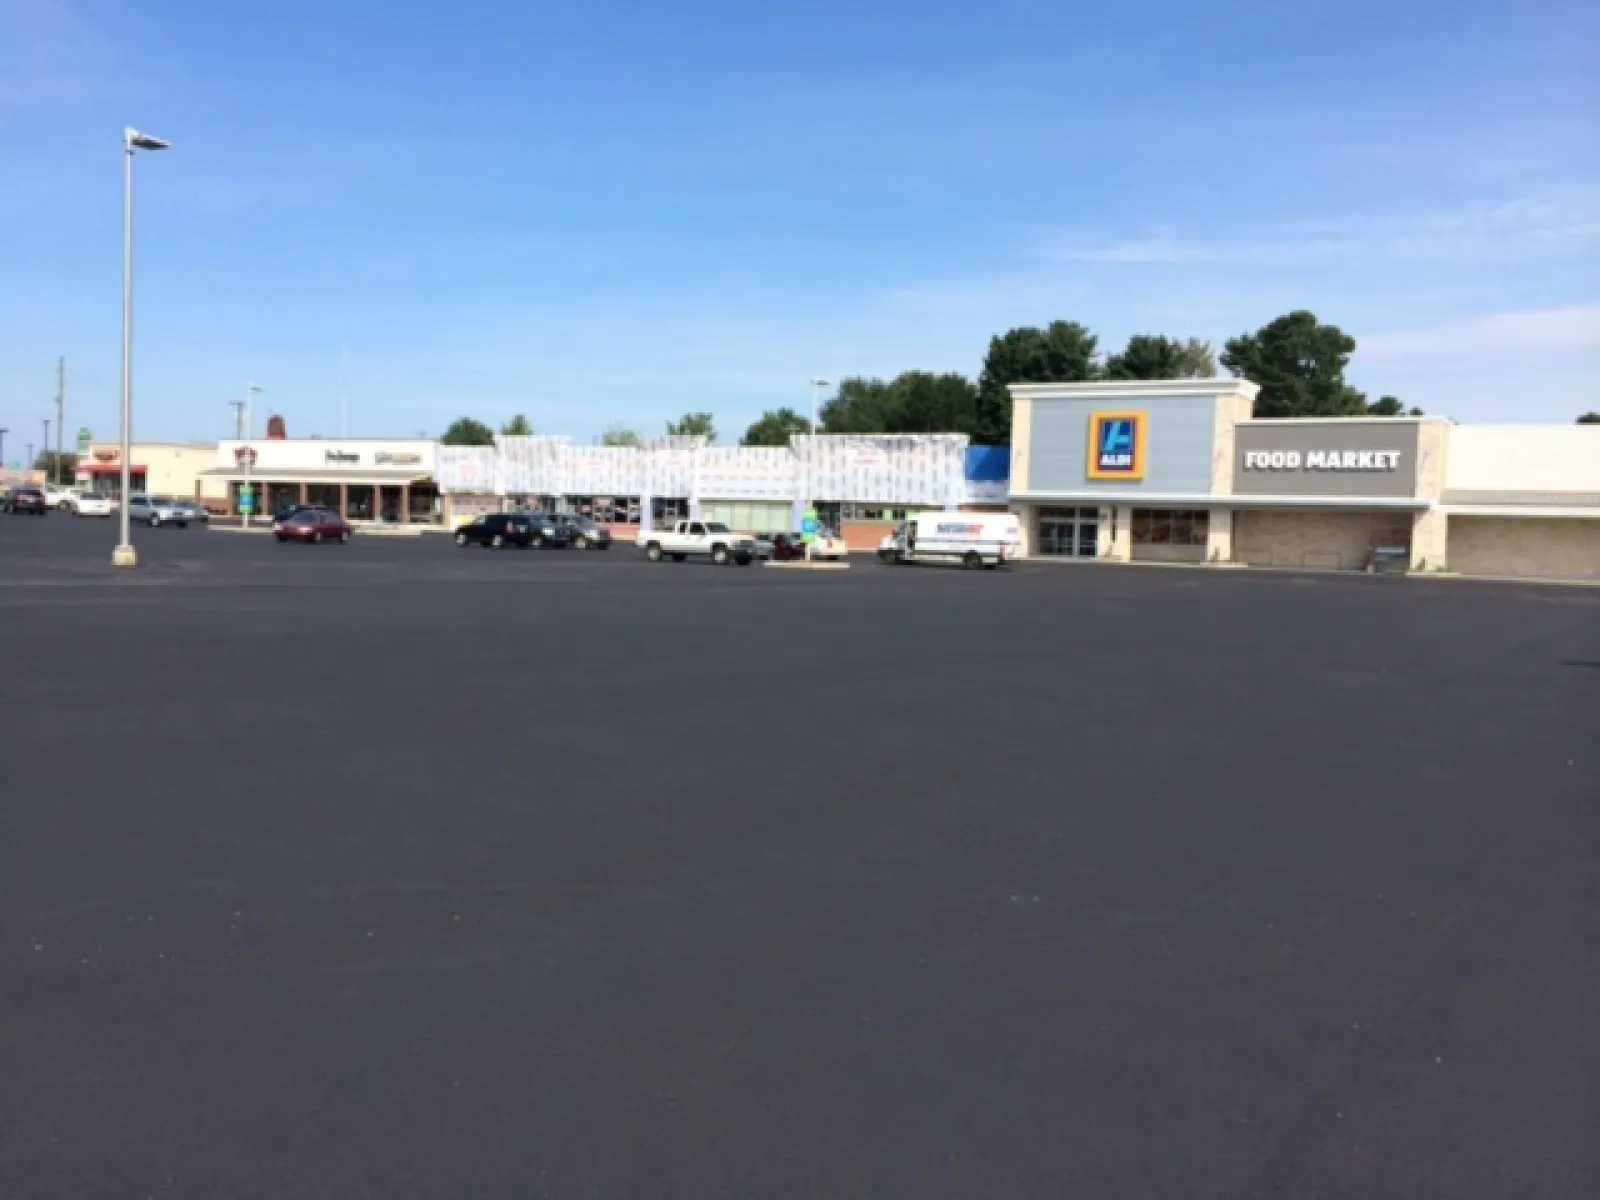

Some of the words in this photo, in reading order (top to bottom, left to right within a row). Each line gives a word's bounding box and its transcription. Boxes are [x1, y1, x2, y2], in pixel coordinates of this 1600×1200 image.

[1099, 453, 1132, 467] ALDI
[1245, 450, 1301, 469] FOOD
[1305, 450, 1401, 469] MARKET
